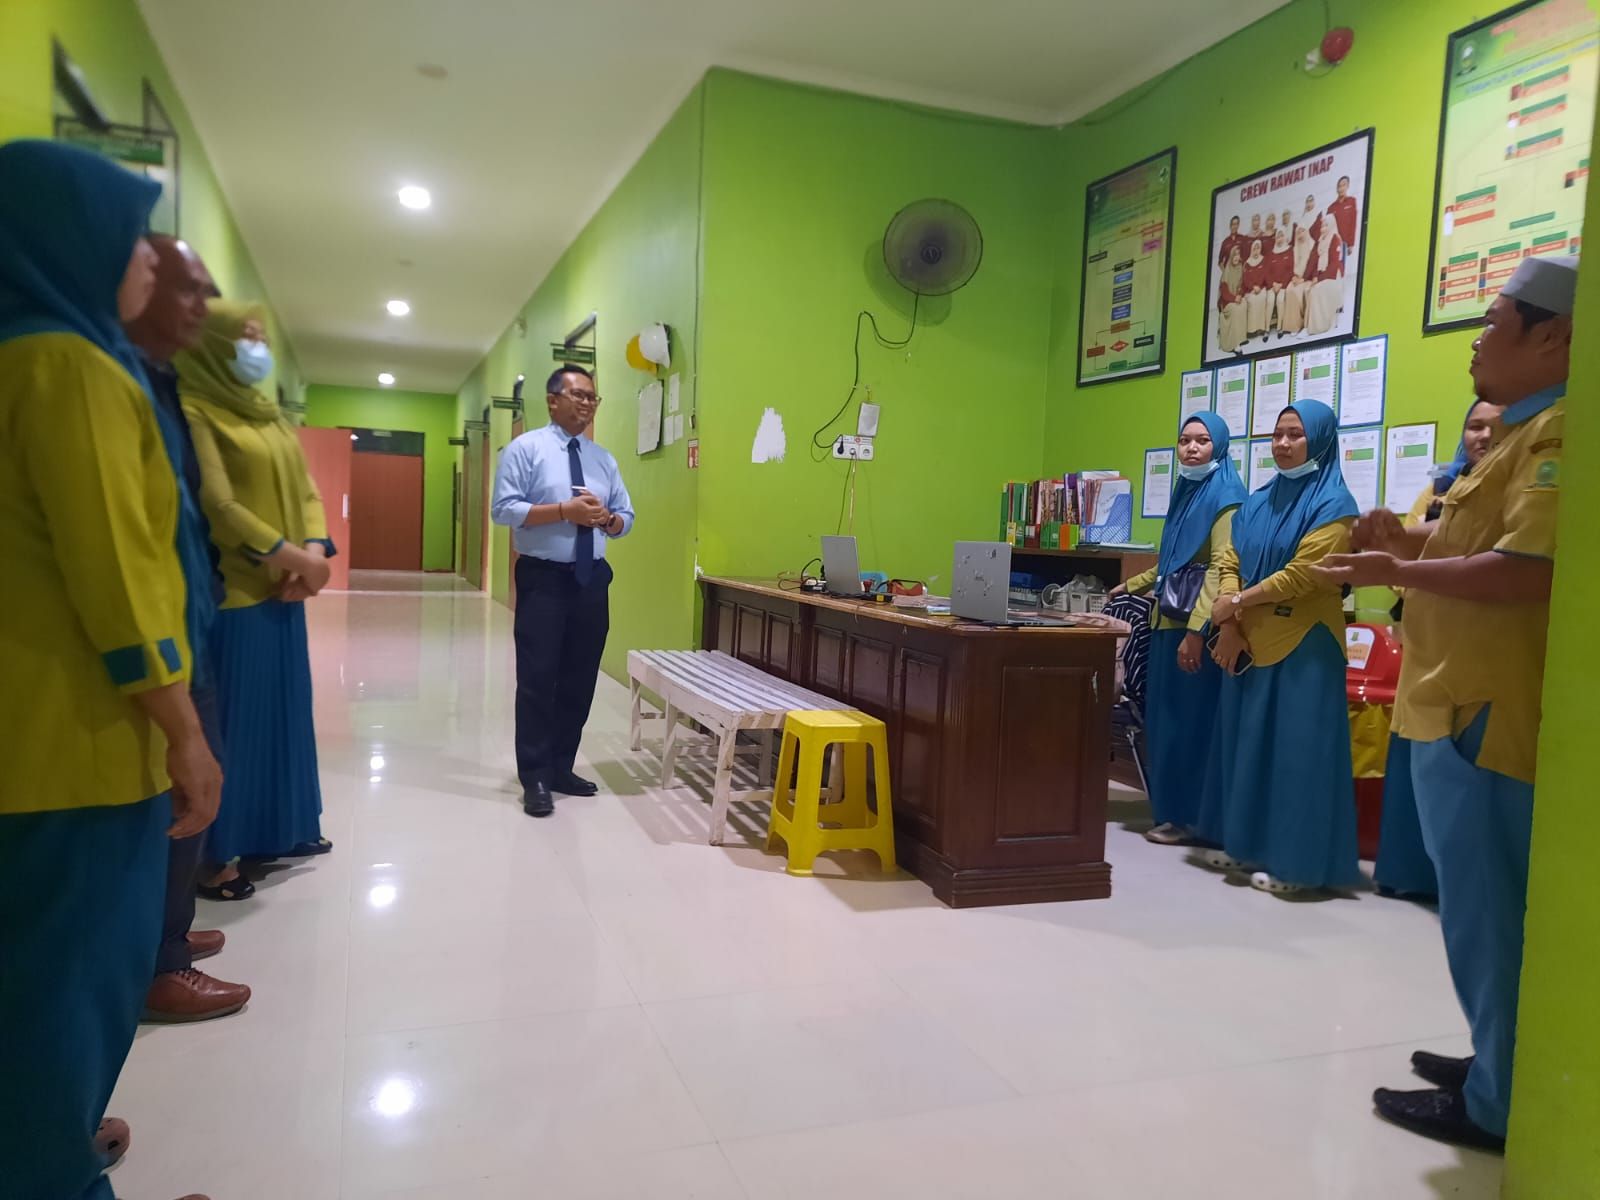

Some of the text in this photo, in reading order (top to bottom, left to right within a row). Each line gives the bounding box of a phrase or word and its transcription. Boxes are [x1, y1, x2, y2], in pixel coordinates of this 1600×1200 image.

[1240, 155, 1334, 203] CREW RAWAT INAP
